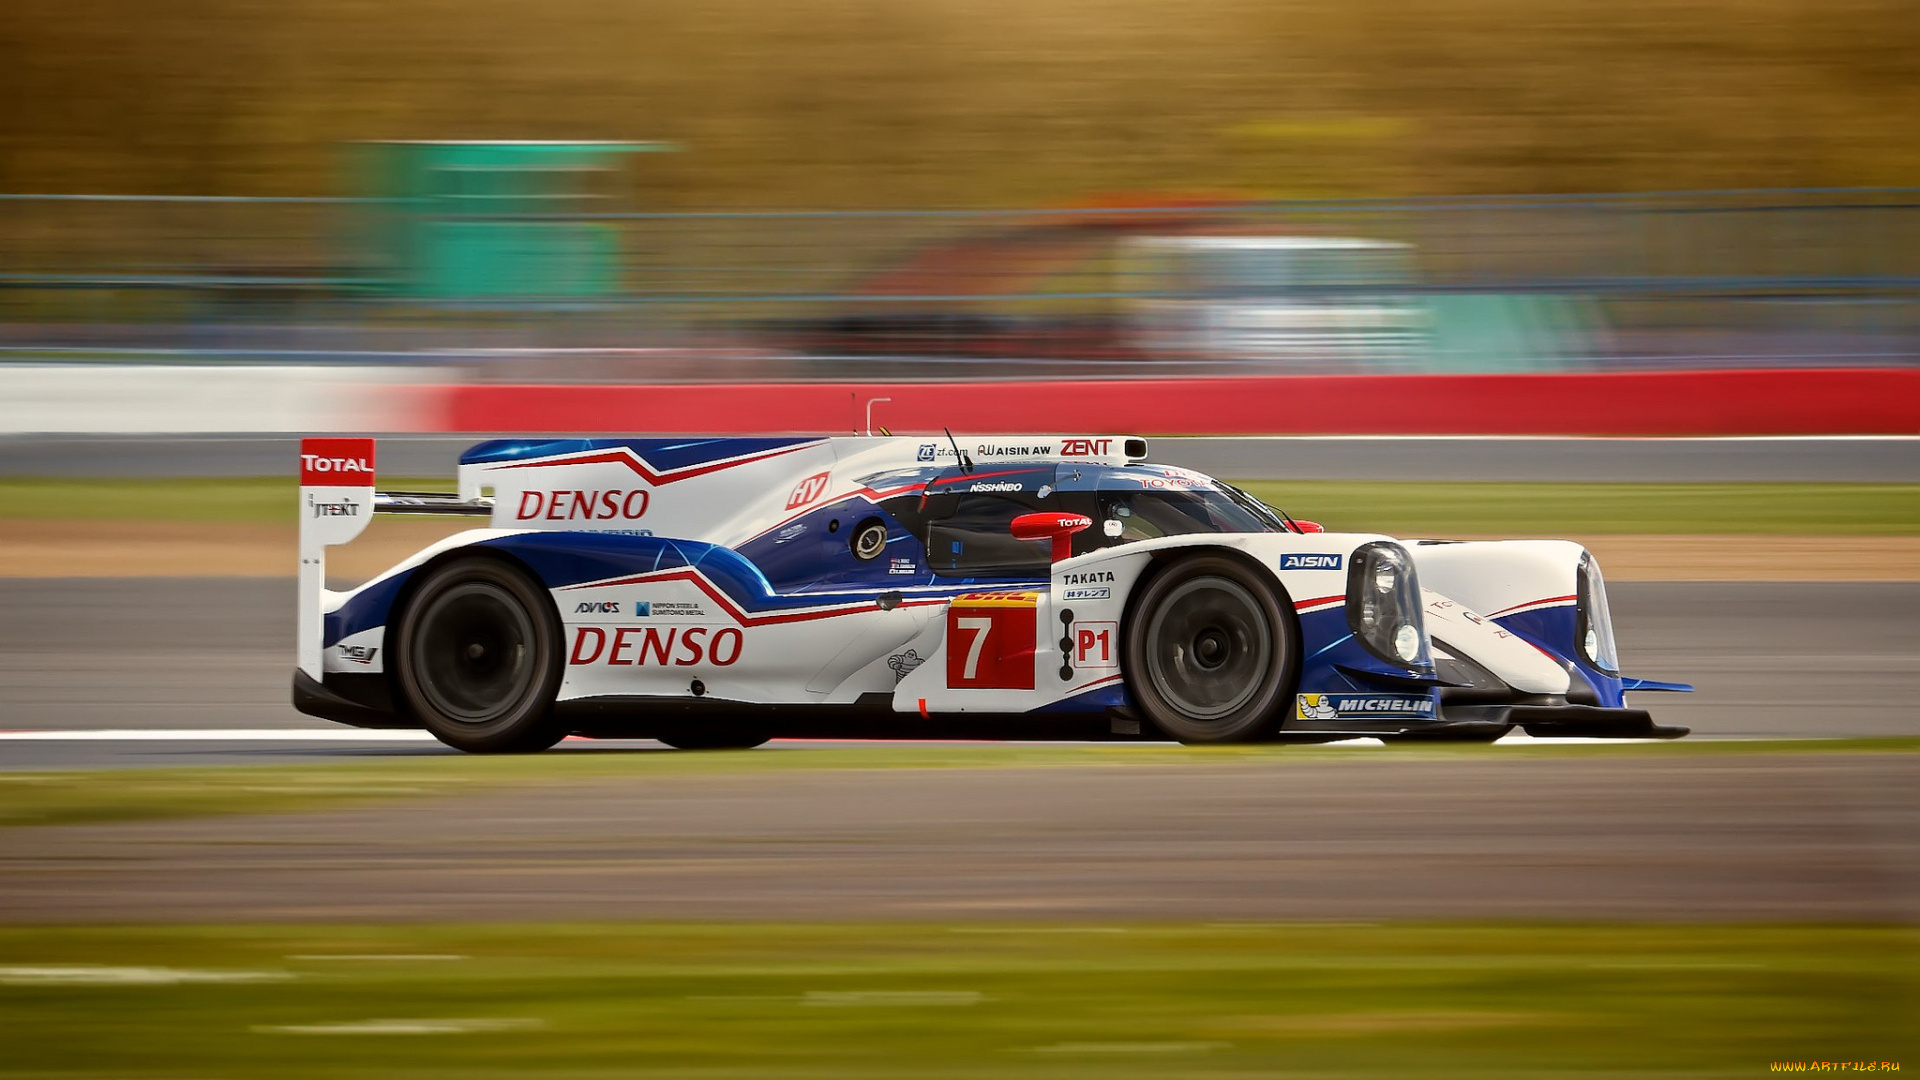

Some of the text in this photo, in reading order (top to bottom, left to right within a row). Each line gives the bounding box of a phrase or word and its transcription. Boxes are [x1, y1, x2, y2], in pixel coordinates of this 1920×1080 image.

[996, 447, 1029, 456] AISIN
[1031, 446, 1051, 455] AW
[1060, 439, 1112, 456] ZENT
[301, 454, 374, 473] TOTAL
[788, 477, 828, 505] HY
[314, 503, 359, 518] JTEKT
[516, 490, 649, 520] DENSO
[1057, 518, 1092, 527] TOTAL
[1284, 556, 1338, 567] AISIN
[1063, 571, 1115, 585] TAKATA
[569, 627, 743, 666] DENSO
[957, 617, 992, 679] 7
[1078, 629, 1109, 661] P1
[1338, 699, 1433, 712] MICHELIN
